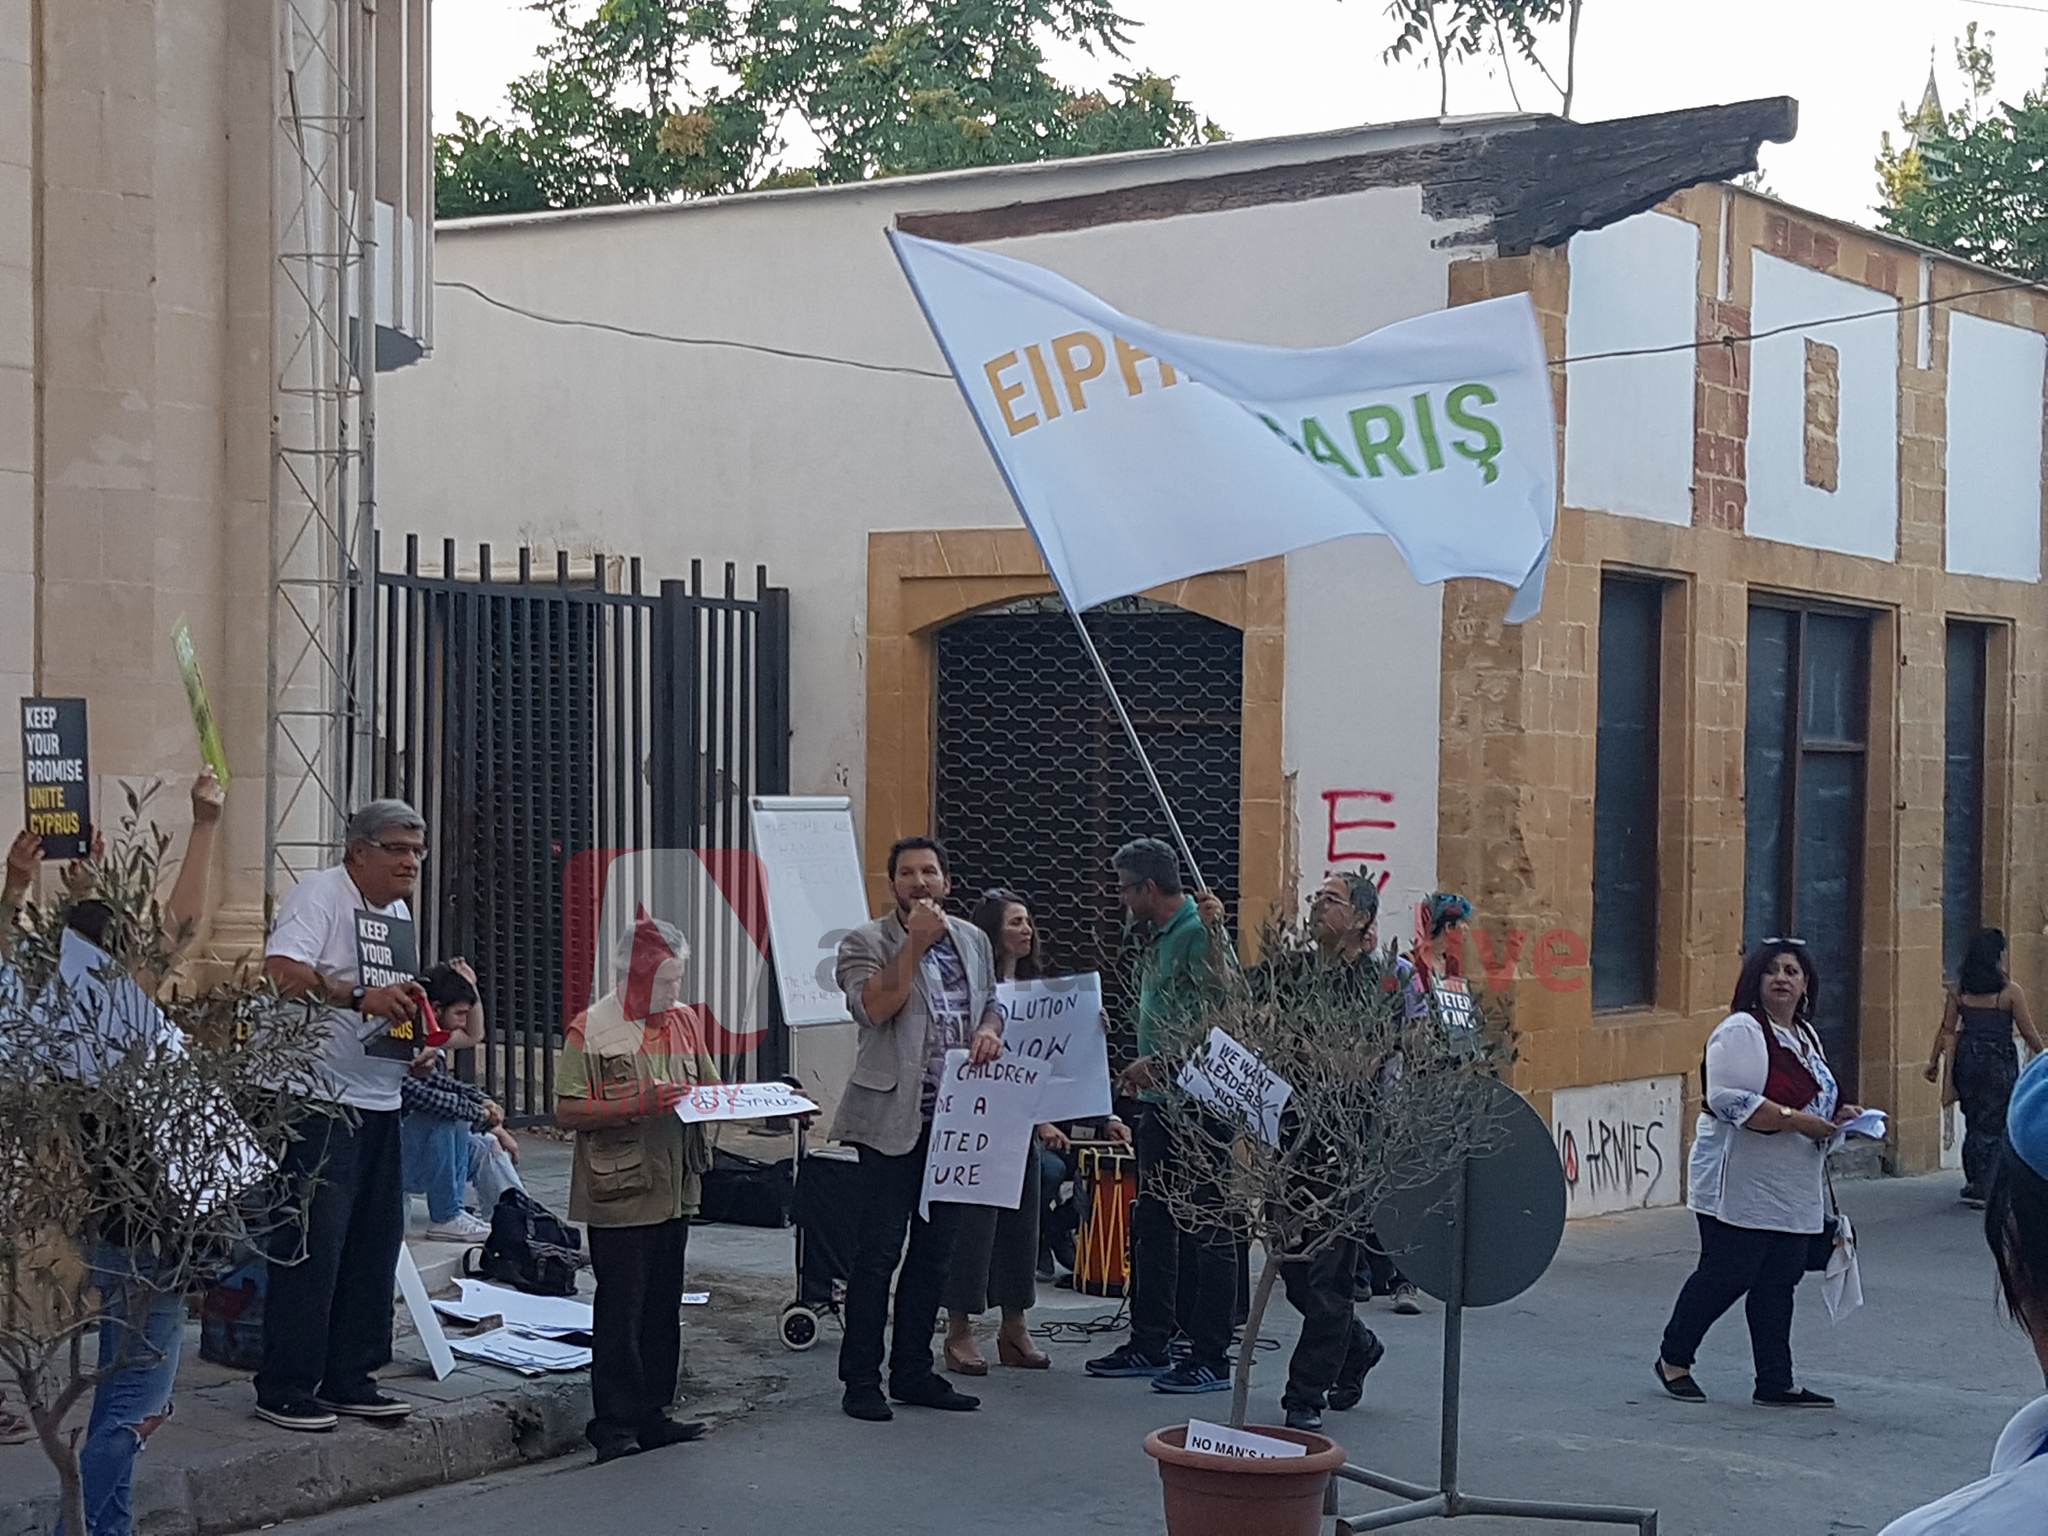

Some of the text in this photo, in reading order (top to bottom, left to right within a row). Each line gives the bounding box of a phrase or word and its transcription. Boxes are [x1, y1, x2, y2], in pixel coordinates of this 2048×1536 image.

[984, 330, 1198, 436] ΕΙΡΗ
[1257, 383, 1503, 485] ARIŞ
[25, 706, 57, 729] KEEP
[26, 733, 60, 755] YOUR
[27, 758, 84, 782] PROMISE
[29, 786, 65, 809] UNITE
[30, 812, 80, 835] CYPRUS
[358, 918, 389, 941] KEEP
[360, 942, 394, 967] YOUR
[956, 1062, 1038, 1085] CHILDREN
[1219, 1043, 1275, 1092] WE WANT
[1206, 1058, 1262, 1108] LEADERS
[1586, 1117, 1664, 1208] ARMIES
[1192, 1436, 1212, 1451] NO
